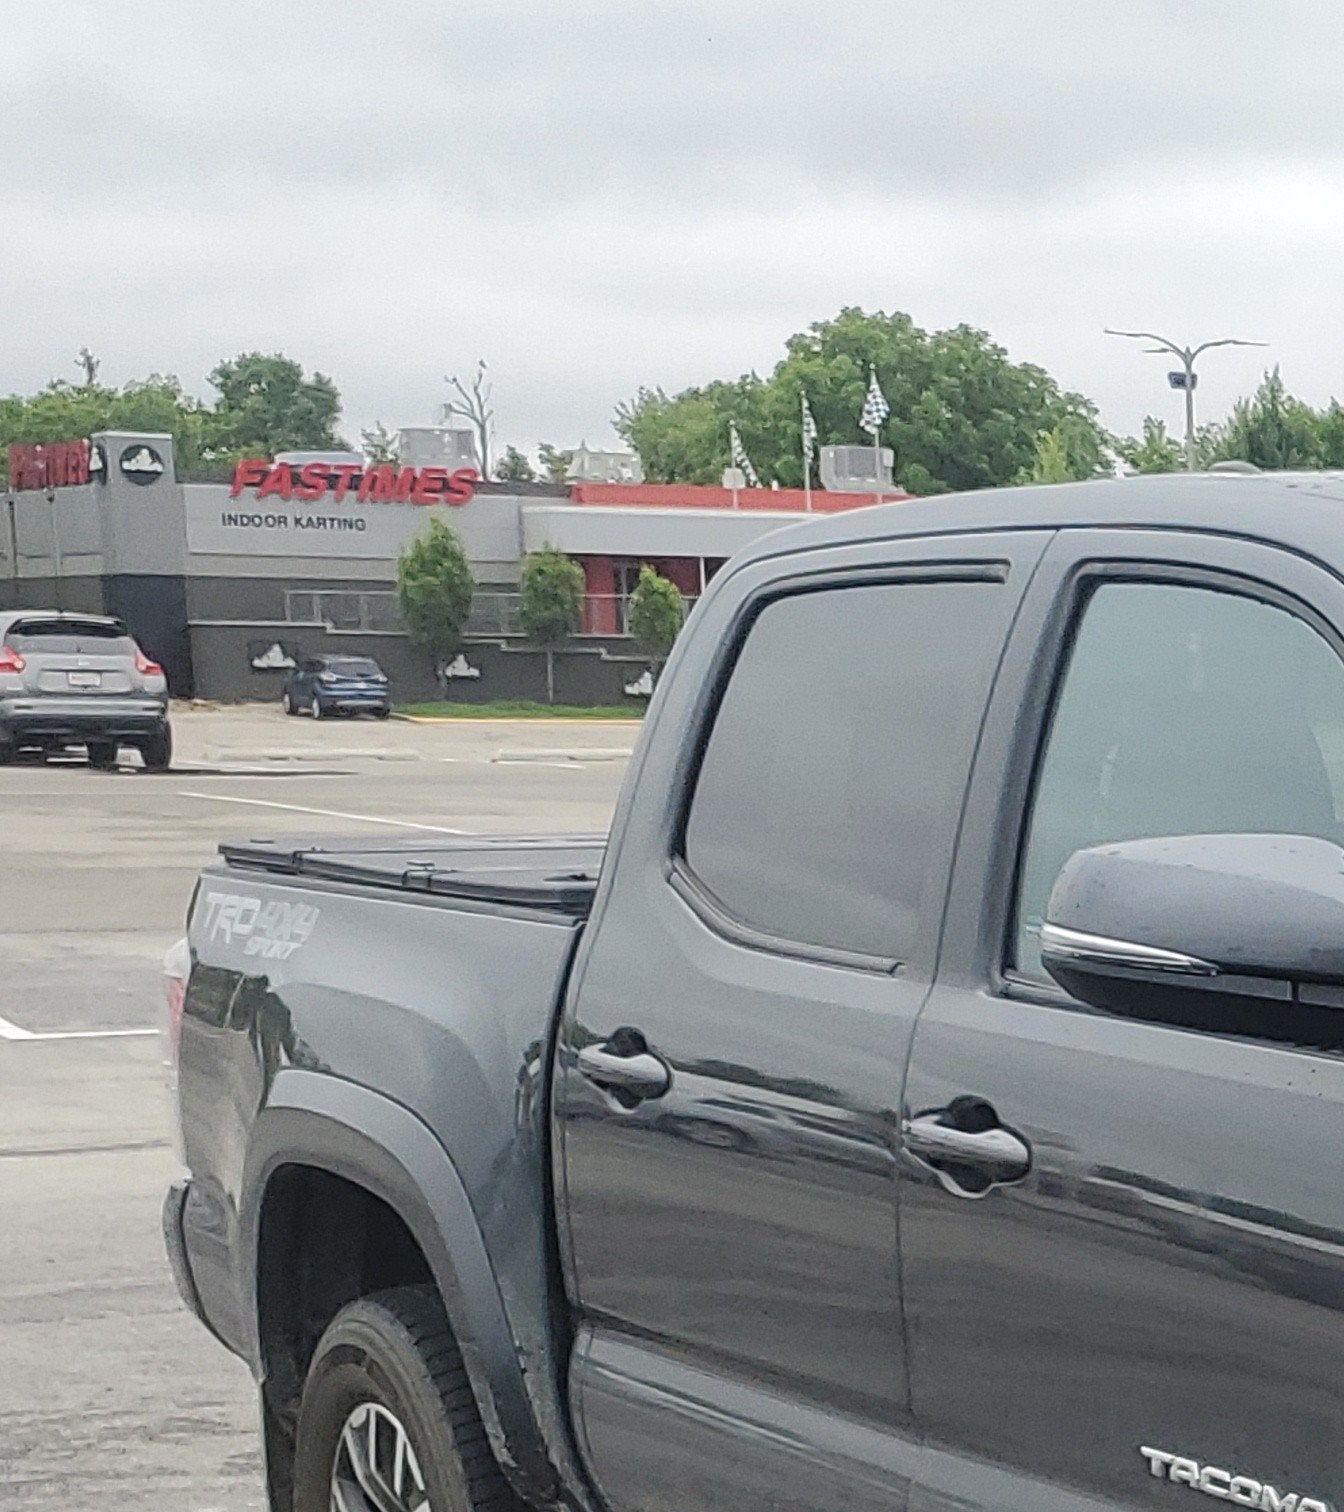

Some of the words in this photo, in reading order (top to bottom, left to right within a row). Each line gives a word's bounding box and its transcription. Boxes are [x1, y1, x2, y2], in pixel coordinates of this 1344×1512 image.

[229, 459, 480, 506] FASTIMES
[221, 512, 289, 529] INDOOR
[294, 514, 367, 532] KARTING
[204, 892, 261, 944] TRD
[243, 936, 302, 960] SPORT
